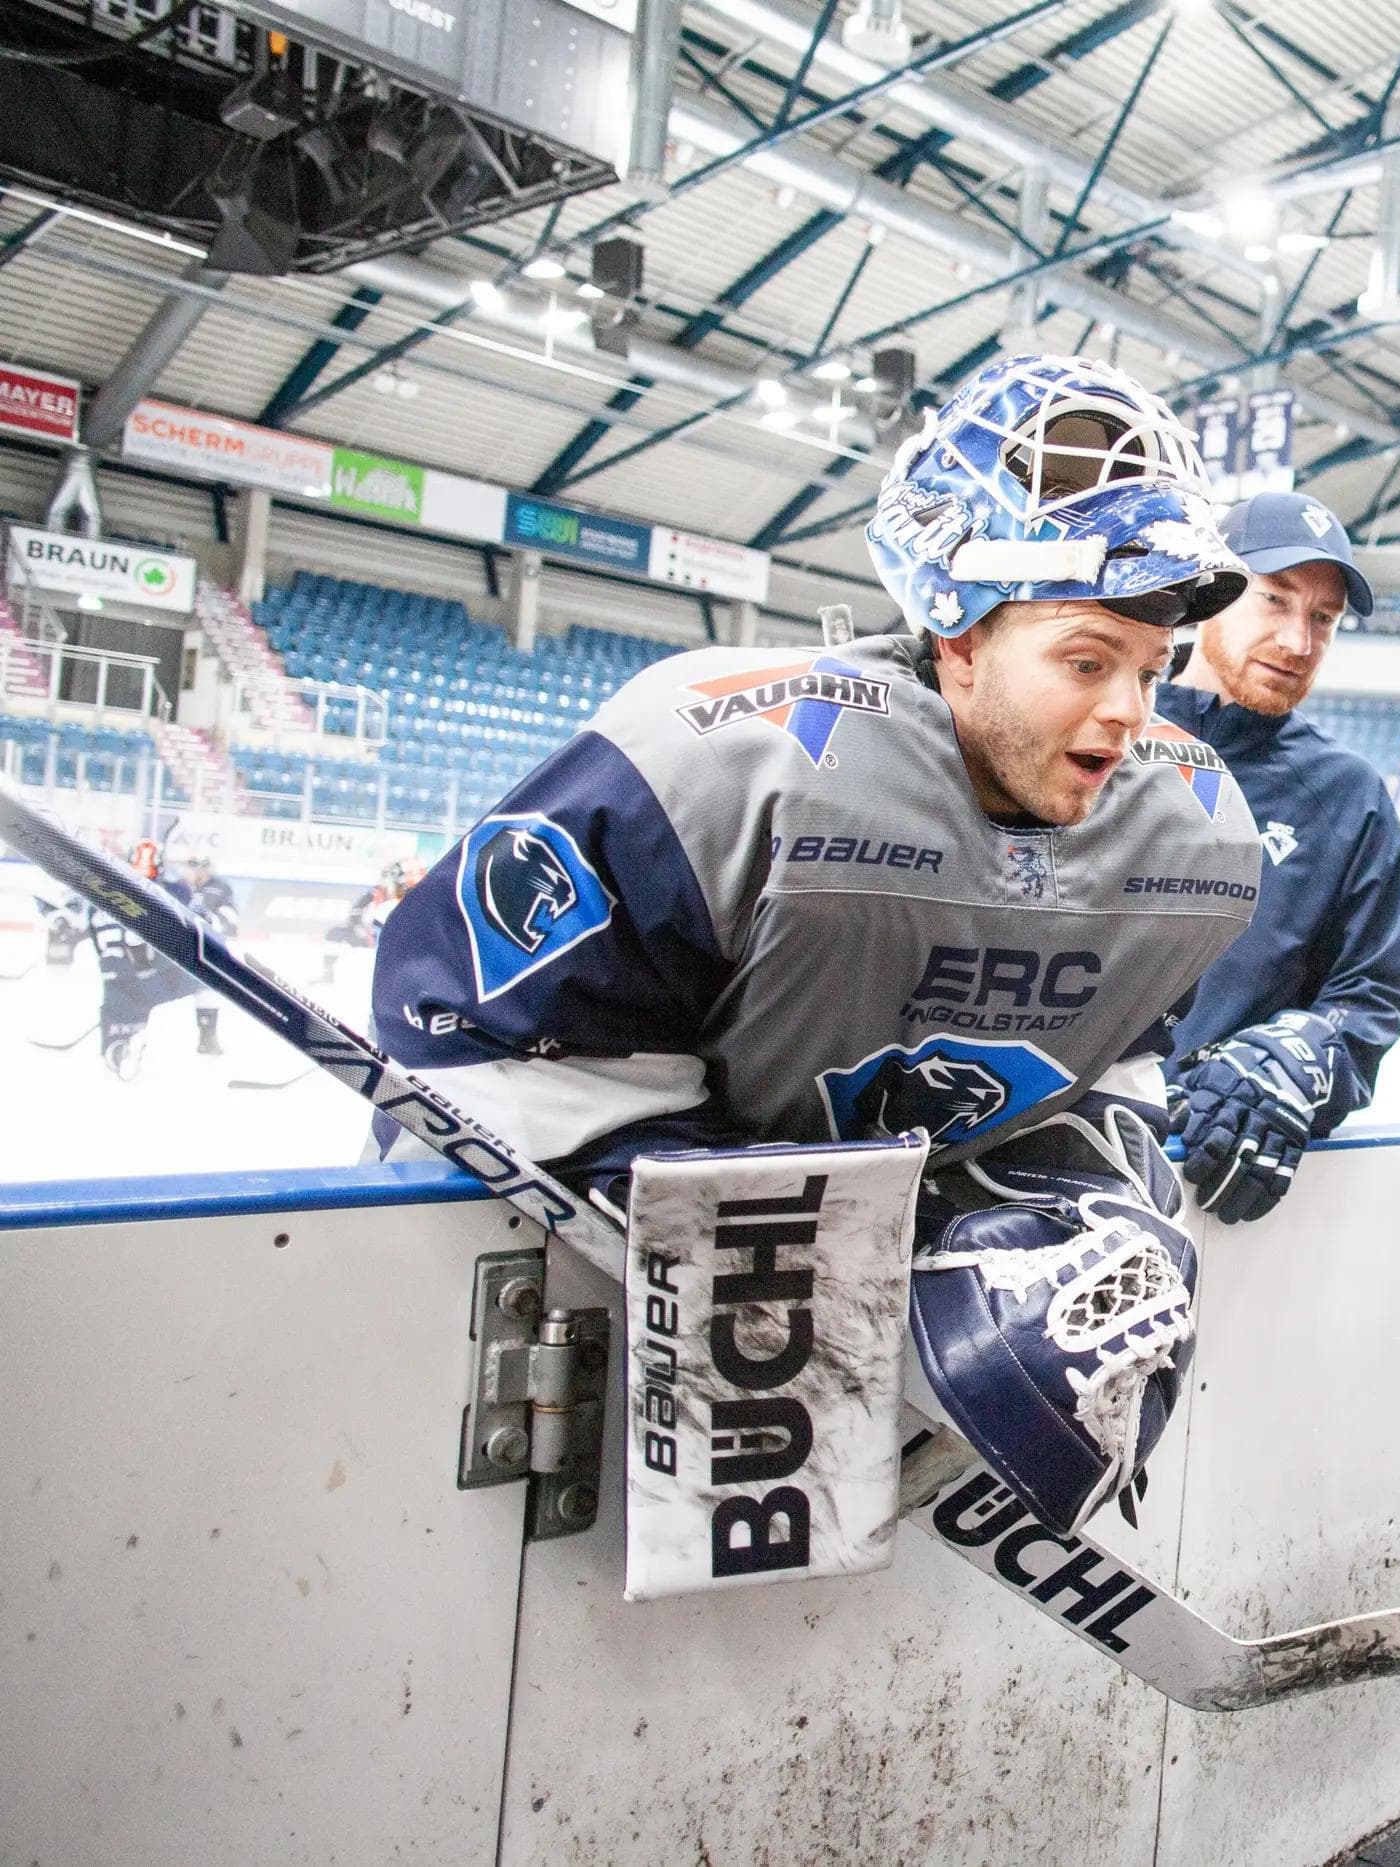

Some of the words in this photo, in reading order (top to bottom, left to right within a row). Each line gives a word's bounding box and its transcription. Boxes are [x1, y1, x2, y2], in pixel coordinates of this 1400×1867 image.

[26, 539, 130, 574] BRAUN
[688, 674, 882, 730] VAUGHN
[1131, 739, 1227, 770] VAUGH
[260, 827, 353, 853] BRAUN
[786, 836, 944, 875] BAUER
[1123, 877, 1257, 902] SHERWOOD
[910, 945, 1102, 1009] ERC
[900, 1001, 1084, 1032] INGOLSTADT
[711, 1174, 829, 1578] BÜCHL
[901, 1428, 1158, 1655] ÜCHL
